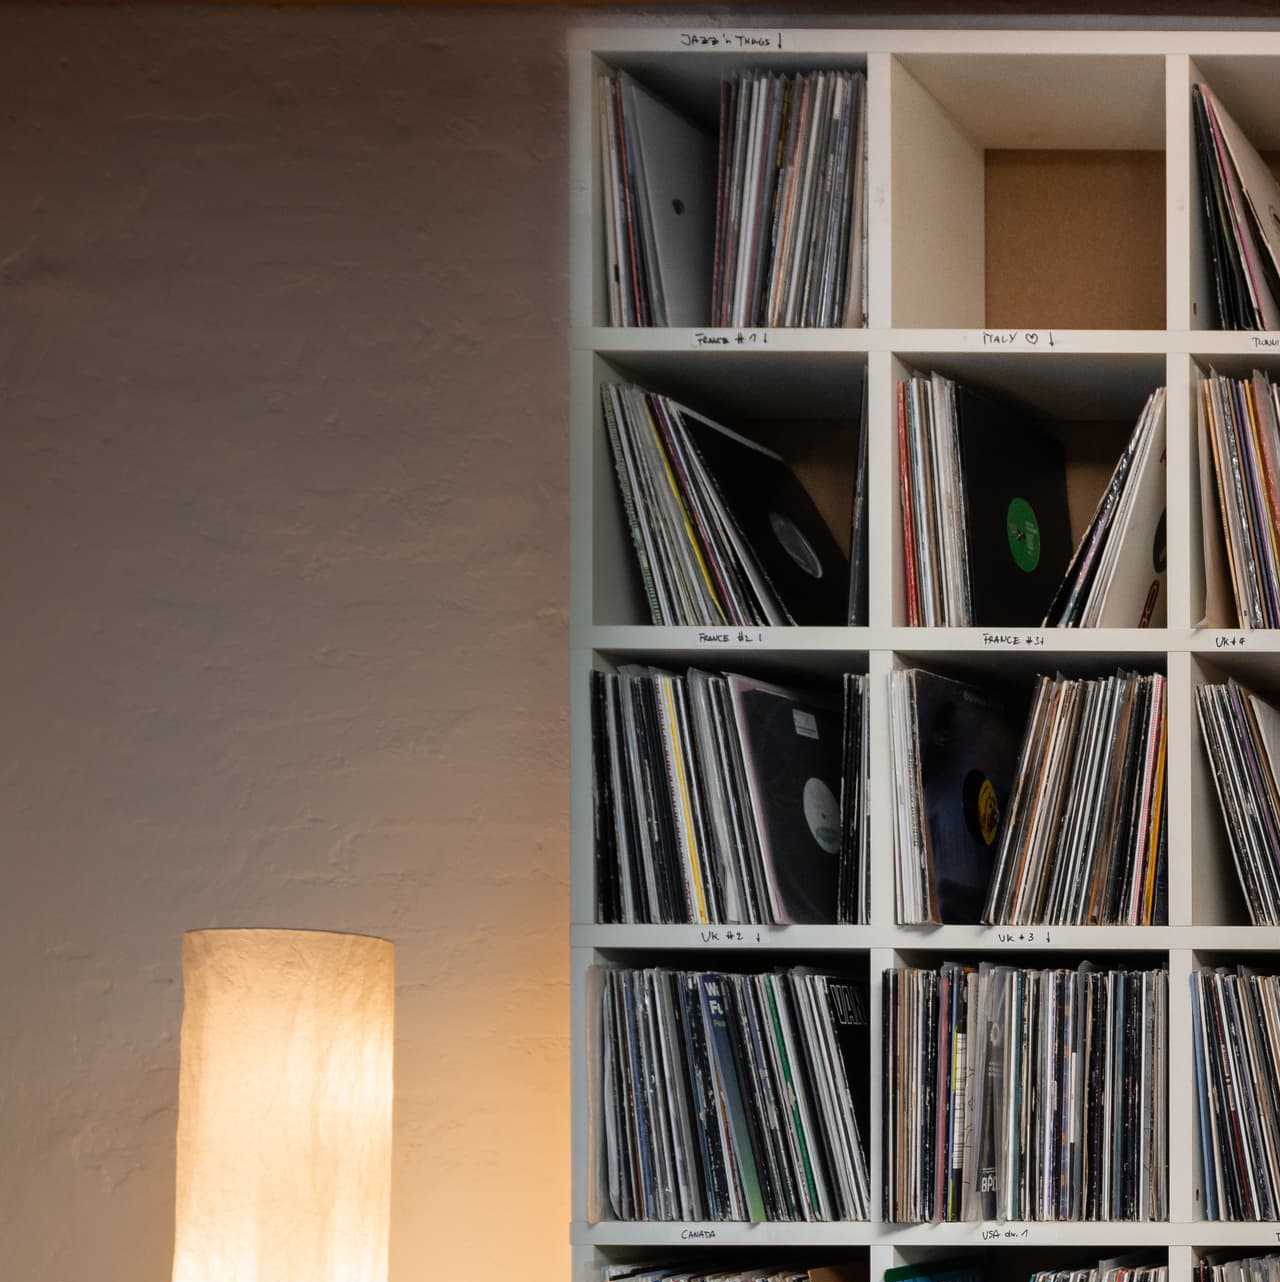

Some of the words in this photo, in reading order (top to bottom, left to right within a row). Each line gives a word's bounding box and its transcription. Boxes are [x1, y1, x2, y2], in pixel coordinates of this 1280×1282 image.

[681, 34, 719, 46] JAZZ
[695, 333, 729, 345] FRANCE
[735, 333, 744, 344] #
[984, 332, 1016, 344] ITALY
[699, 633, 729, 642] FRANCE
[983, 633, 1020, 645] FRANCE
[1216, 637, 1229, 648] UK
[701, 931, 719, 943] UK
[998, 934, 1014, 942] UK
[681, 1230, 715, 1239] CANADA
[982, 1230, 1000, 1240] USA
